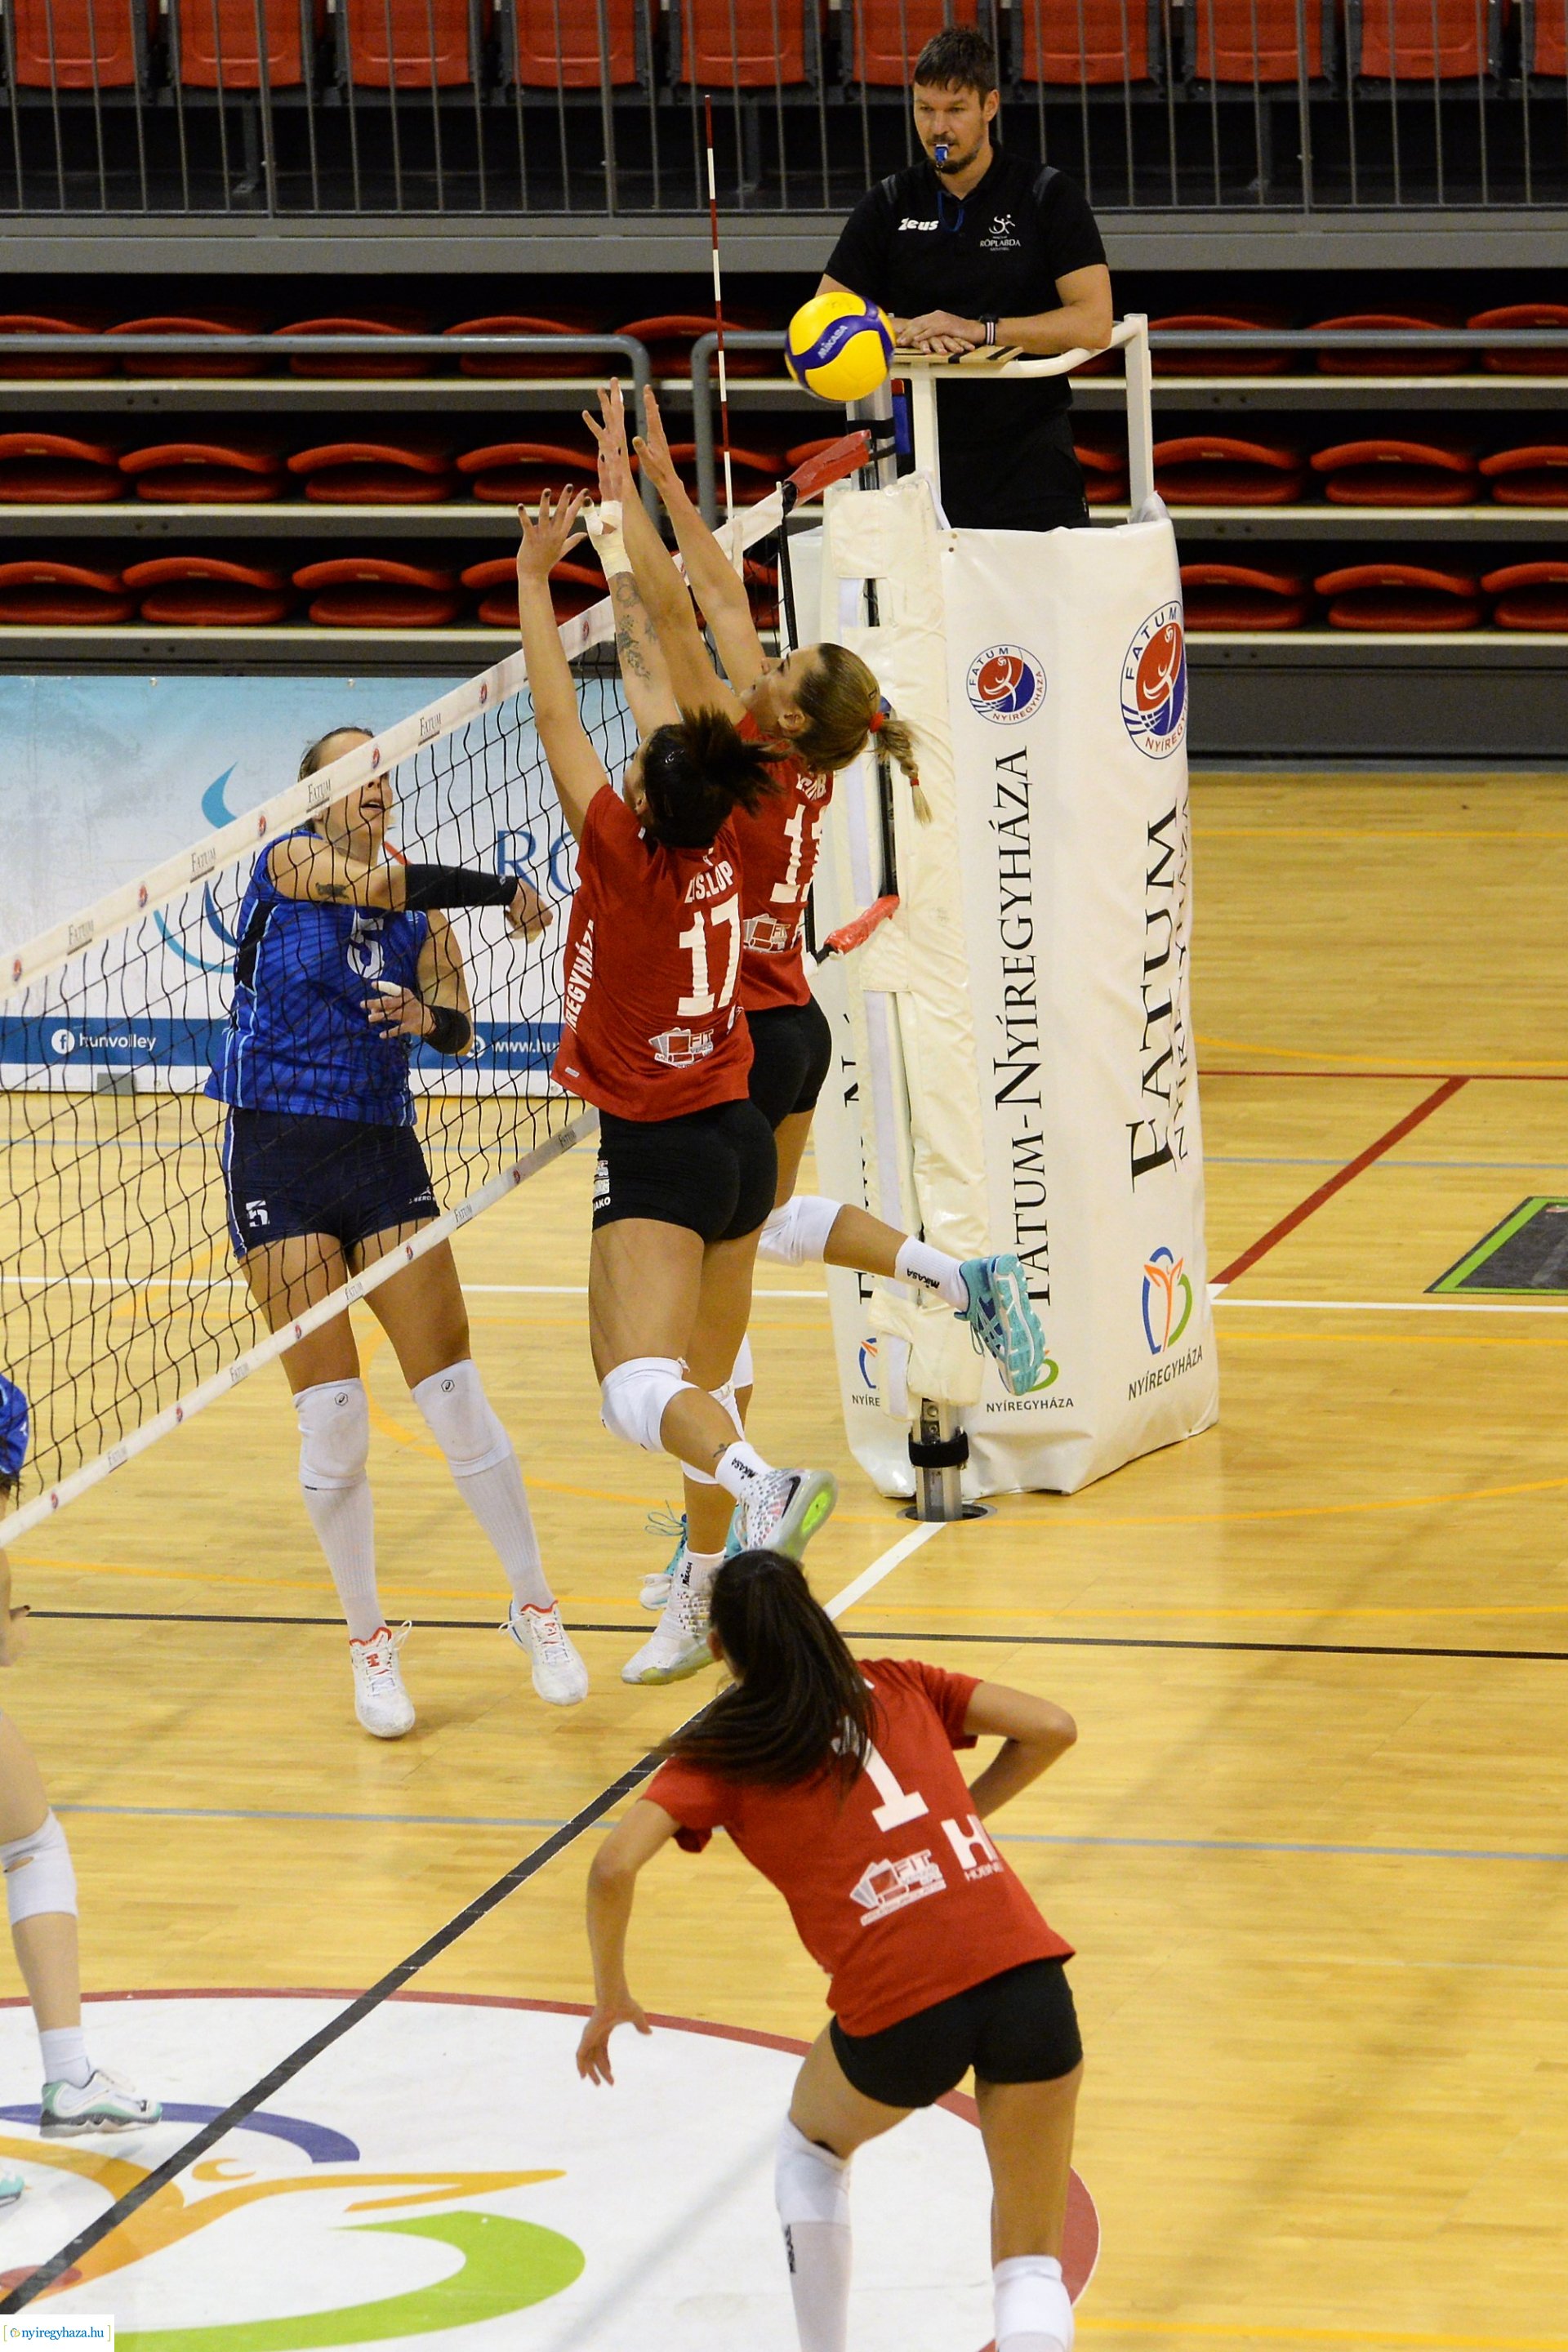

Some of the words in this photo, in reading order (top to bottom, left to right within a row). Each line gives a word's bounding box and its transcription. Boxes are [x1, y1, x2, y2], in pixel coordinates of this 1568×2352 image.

[969, 647, 1009, 686] FATUM
[1125, 607, 1177, 679] FATUM
[347, 909, 385, 979] 5
[676, 892, 741, 1017] 17
[1125, 797, 1178, 1194] FATUM
[79, 1032, 157, 1052] hunvolley
[246, 1200, 268, 1227] 5
[1129, 1344, 1203, 1401] NYÍREGYHÁZA
[986, 1396, 1075, 1413] NYÍREGYHÁZA
